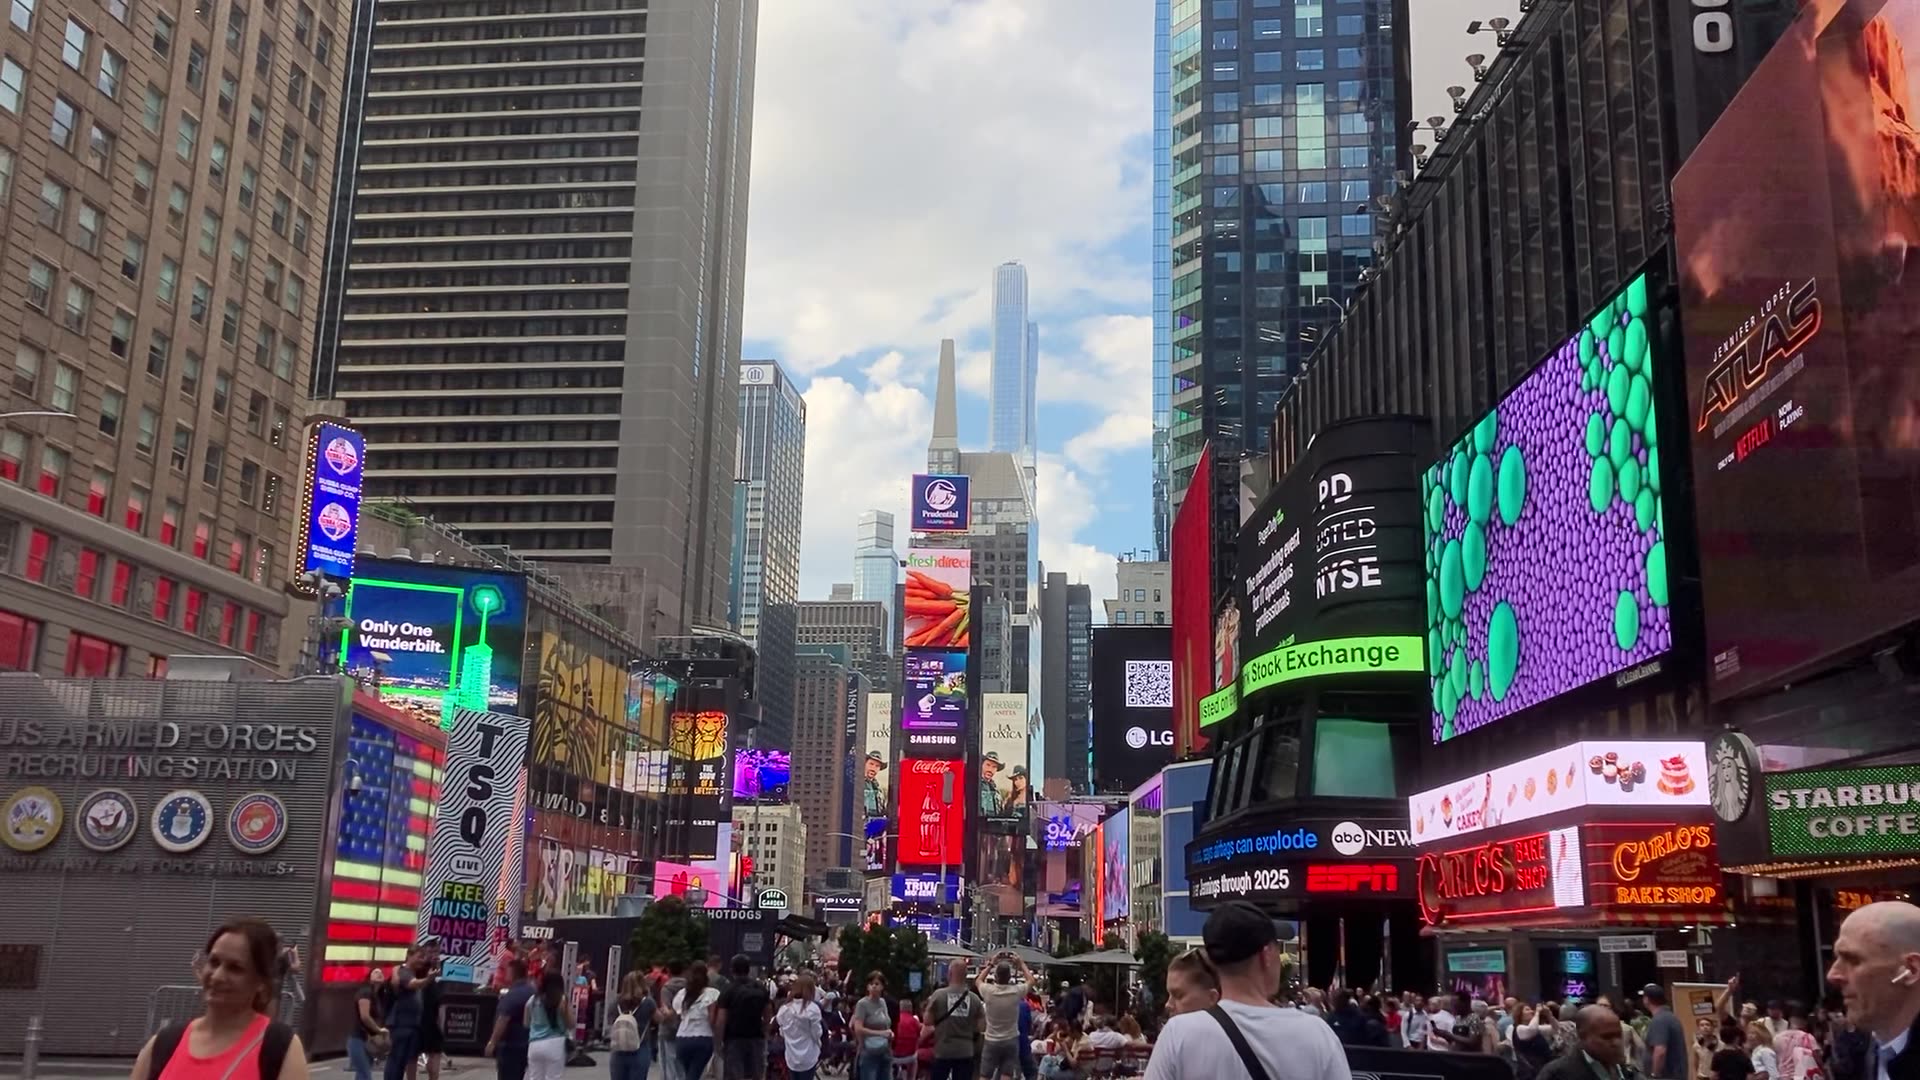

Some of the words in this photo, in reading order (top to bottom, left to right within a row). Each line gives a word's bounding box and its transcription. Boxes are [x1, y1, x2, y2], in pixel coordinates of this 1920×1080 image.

[1713, 315, 1756, 362] JENNIFER
[1760, 281, 1791, 317] LOPEZ
[1697, 277, 1822, 432] ATLAS
[1778, 399, 1793, 418] NOW
[1779, 405, 1803, 431] PLAYING
[1736, 418, 1769, 462] NETFLIX
[922, 510, 959, 518] Prudential
[1316, 556, 1382, 599] NYSE
[360, 619, 397, 636] Only
[400, 621, 433, 637] One
[360, 634, 446, 654] Vanderbilt.
[1252, 655, 1282, 682] Stock
[1286, 645, 1401, 672] Exchange
[54, 720, 180, 748] ARMED
[186, 723, 318, 752] FORCES
[910, 735, 957, 745] SAMSUNG
[987, 731, 1022, 739] TOXICA
[1150, 730, 1174, 746] LG
[5, 754, 175, 778] RECRUITING
[181, 757, 297, 780] STATION
[912, 760, 951, 774] Coca-Cola
[1236, 838, 1254, 854] can
[1255, 828, 1319, 855] explode
[1334, 832, 1362, 844] abc
[1365, 829, 1419, 847] NEW
[1515, 838, 1546, 863] BAKE
[1613, 826, 1711, 881] CARLO'S
[219, 860, 286, 875] MARINES
[456, 859, 480, 871] LIVE
[1221, 871, 1252, 896] through
[1254, 868, 1290, 890] 2025
[1306, 864, 1399, 892] ESPN
[1516, 865, 1547, 891] SHOP
[442, 882, 484, 902] FREE
[1616, 886, 1665, 904] BAKE
[1666, 886, 1716, 904] SHOP
[433, 900, 488, 920] MUSIC
[707, 909, 762, 920] HOTDOGS
[430, 918, 487, 939] DANCE
[440, 938, 475, 957] ART
